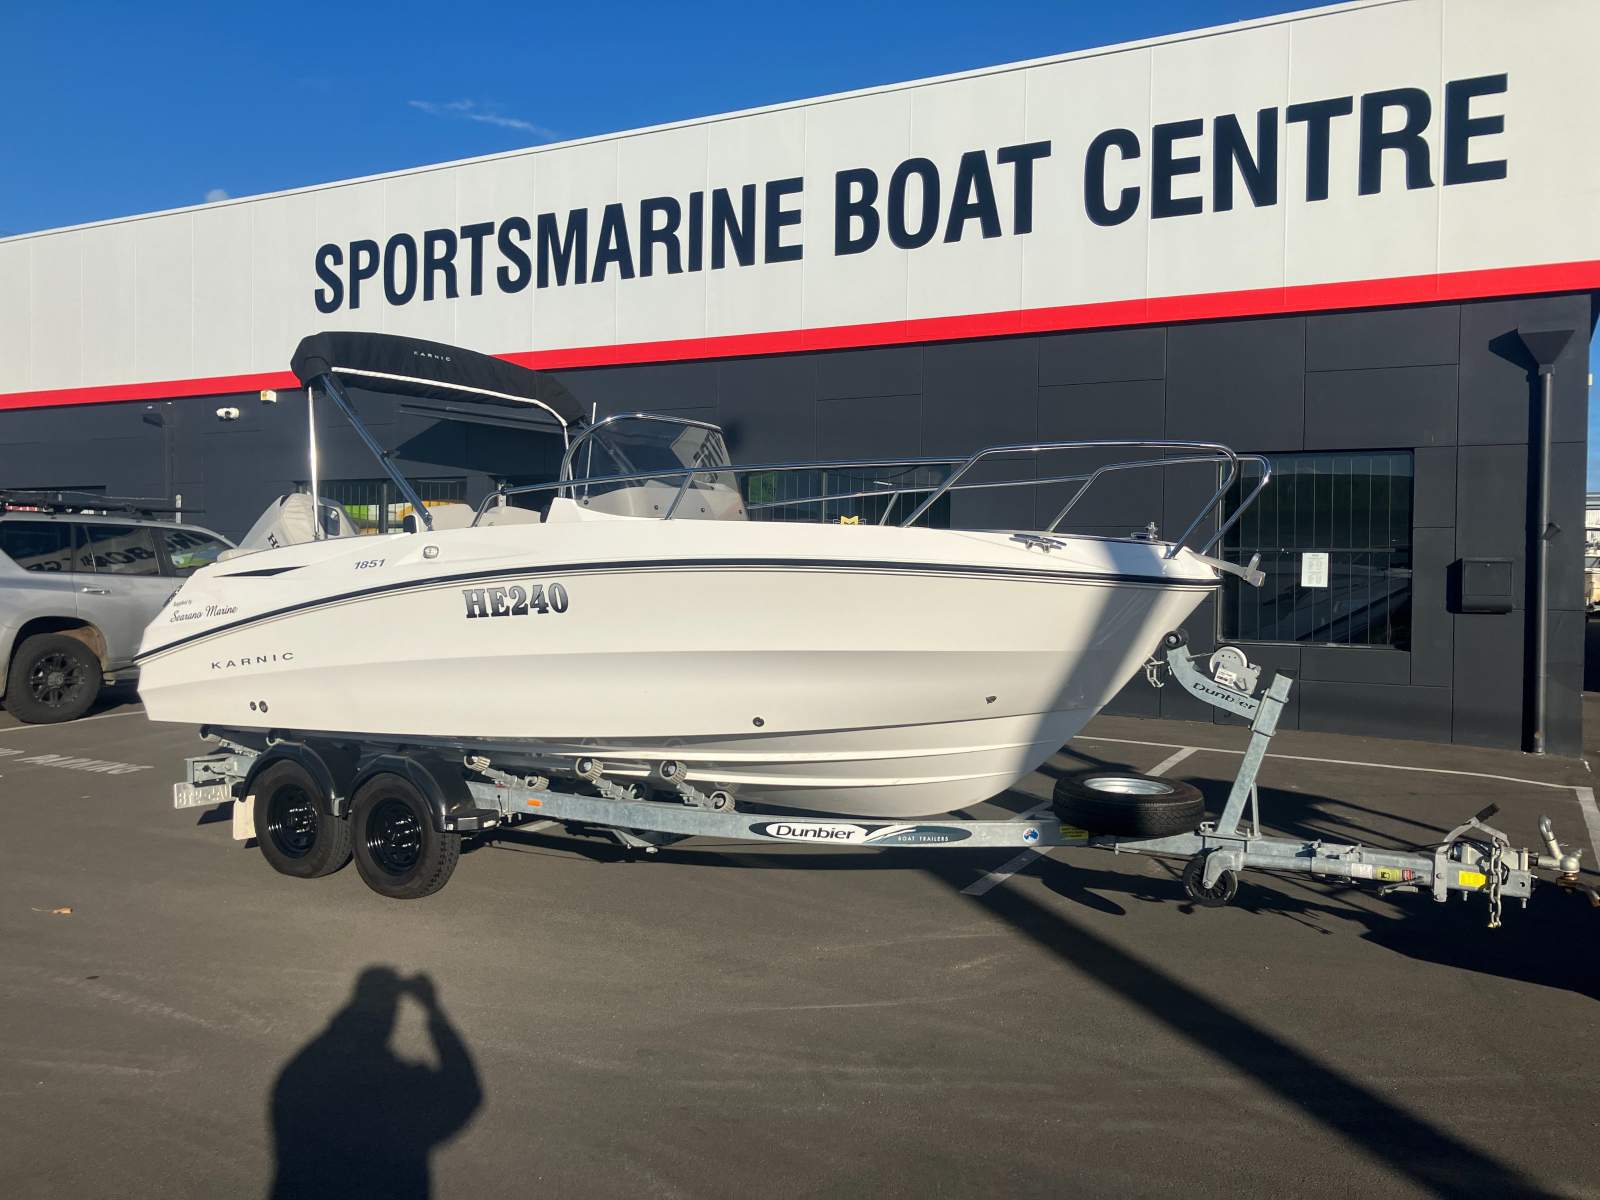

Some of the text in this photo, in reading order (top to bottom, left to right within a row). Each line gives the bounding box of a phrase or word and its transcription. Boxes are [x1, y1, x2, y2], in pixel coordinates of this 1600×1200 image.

[314, 72, 1508, 314] SPORTSMARINE BOAT CENTRE
[413, 350, 452, 362] KARNIC
[354, 558, 386, 570] 1851
[462, 582, 569, 619] HE240
[205, 604, 238, 617] Marine
[211, 652, 294, 669] KARNIC
[775, 825, 855, 840] Dunbier
